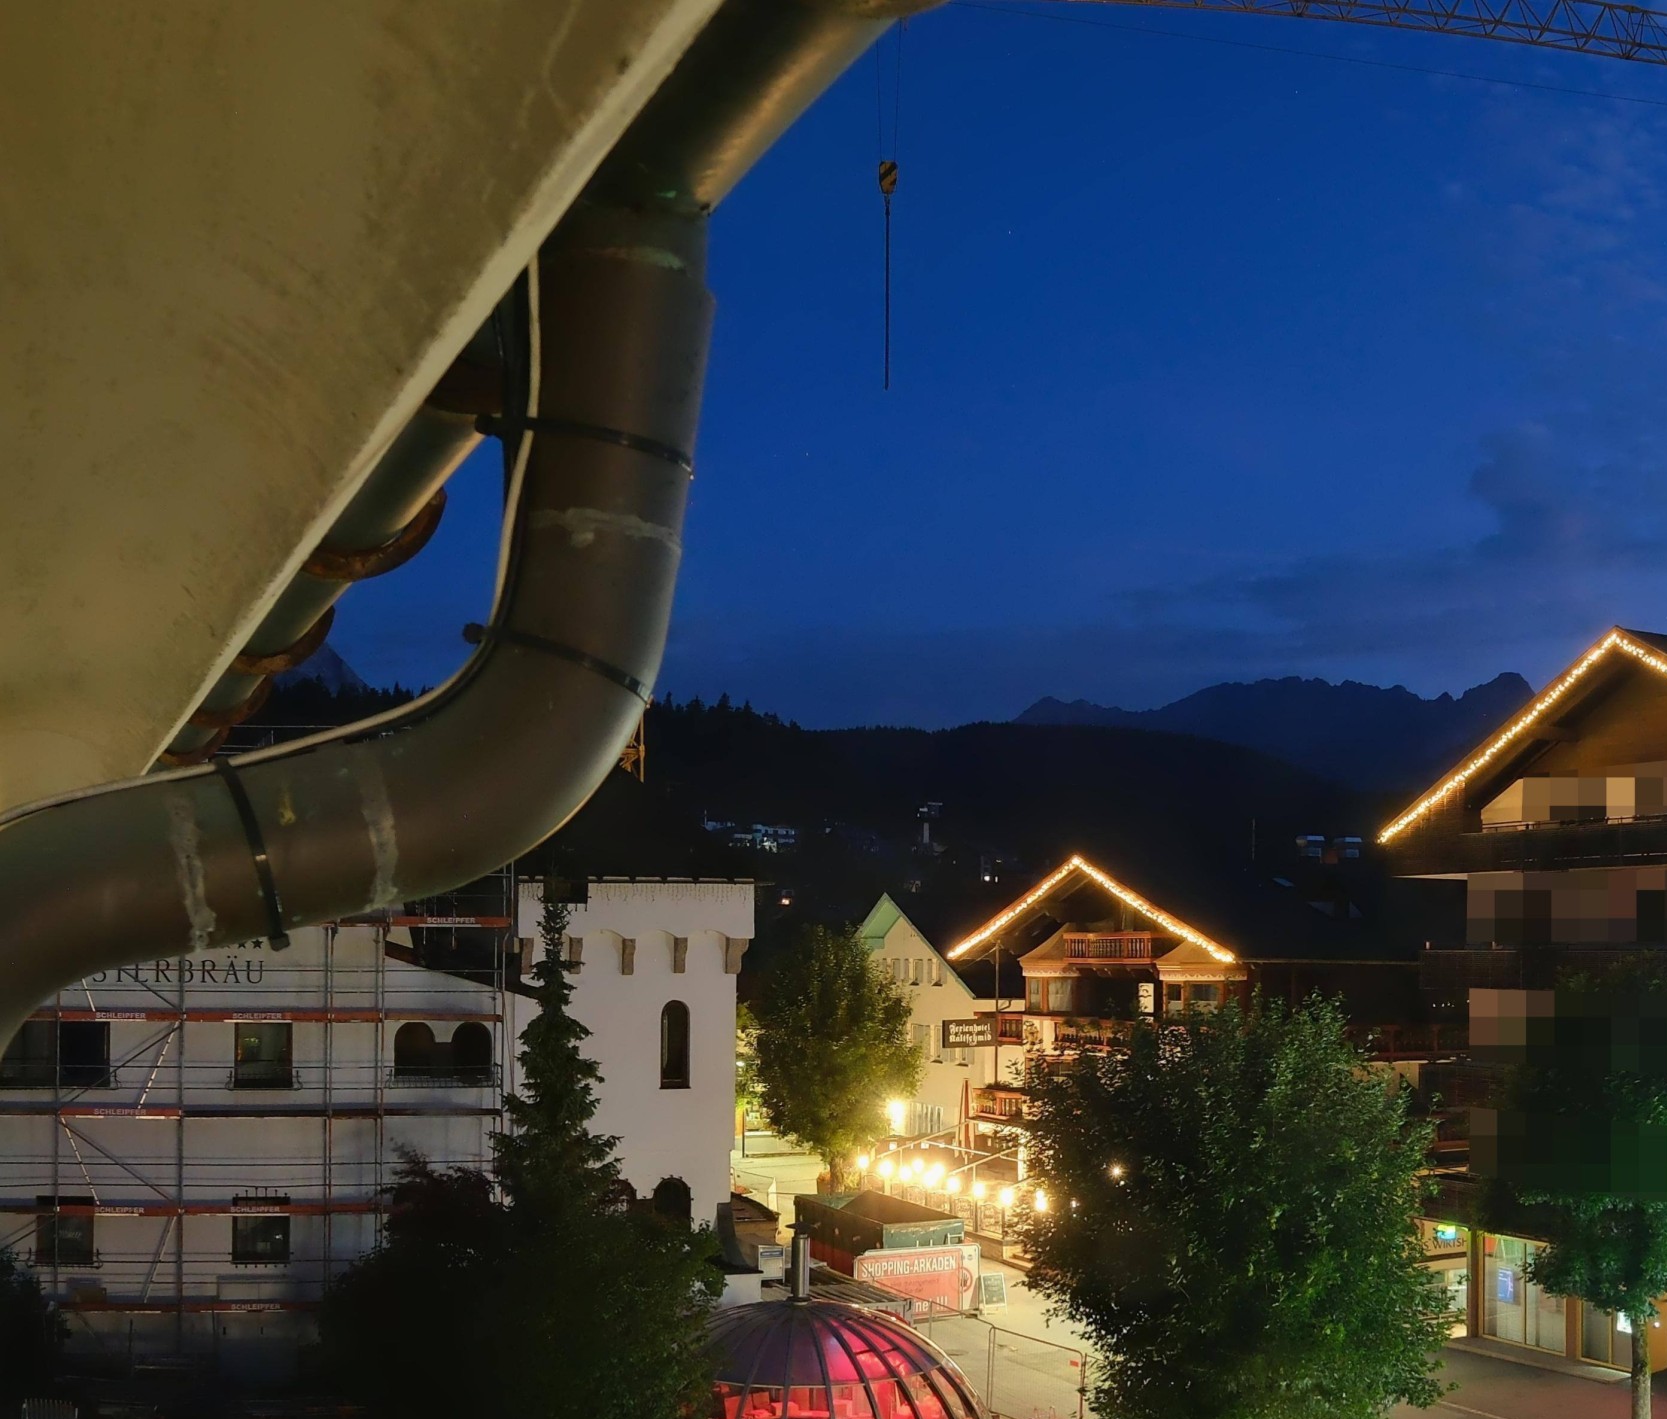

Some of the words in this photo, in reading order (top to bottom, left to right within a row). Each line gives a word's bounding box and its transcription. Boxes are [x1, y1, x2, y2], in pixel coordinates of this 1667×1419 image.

[426, 916, 476, 925] SCHLEIPFER
[94, 1108, 147, 1116] SCHLEIPFER
[94, 1206, 145, 1214] SCHLEIPFER
